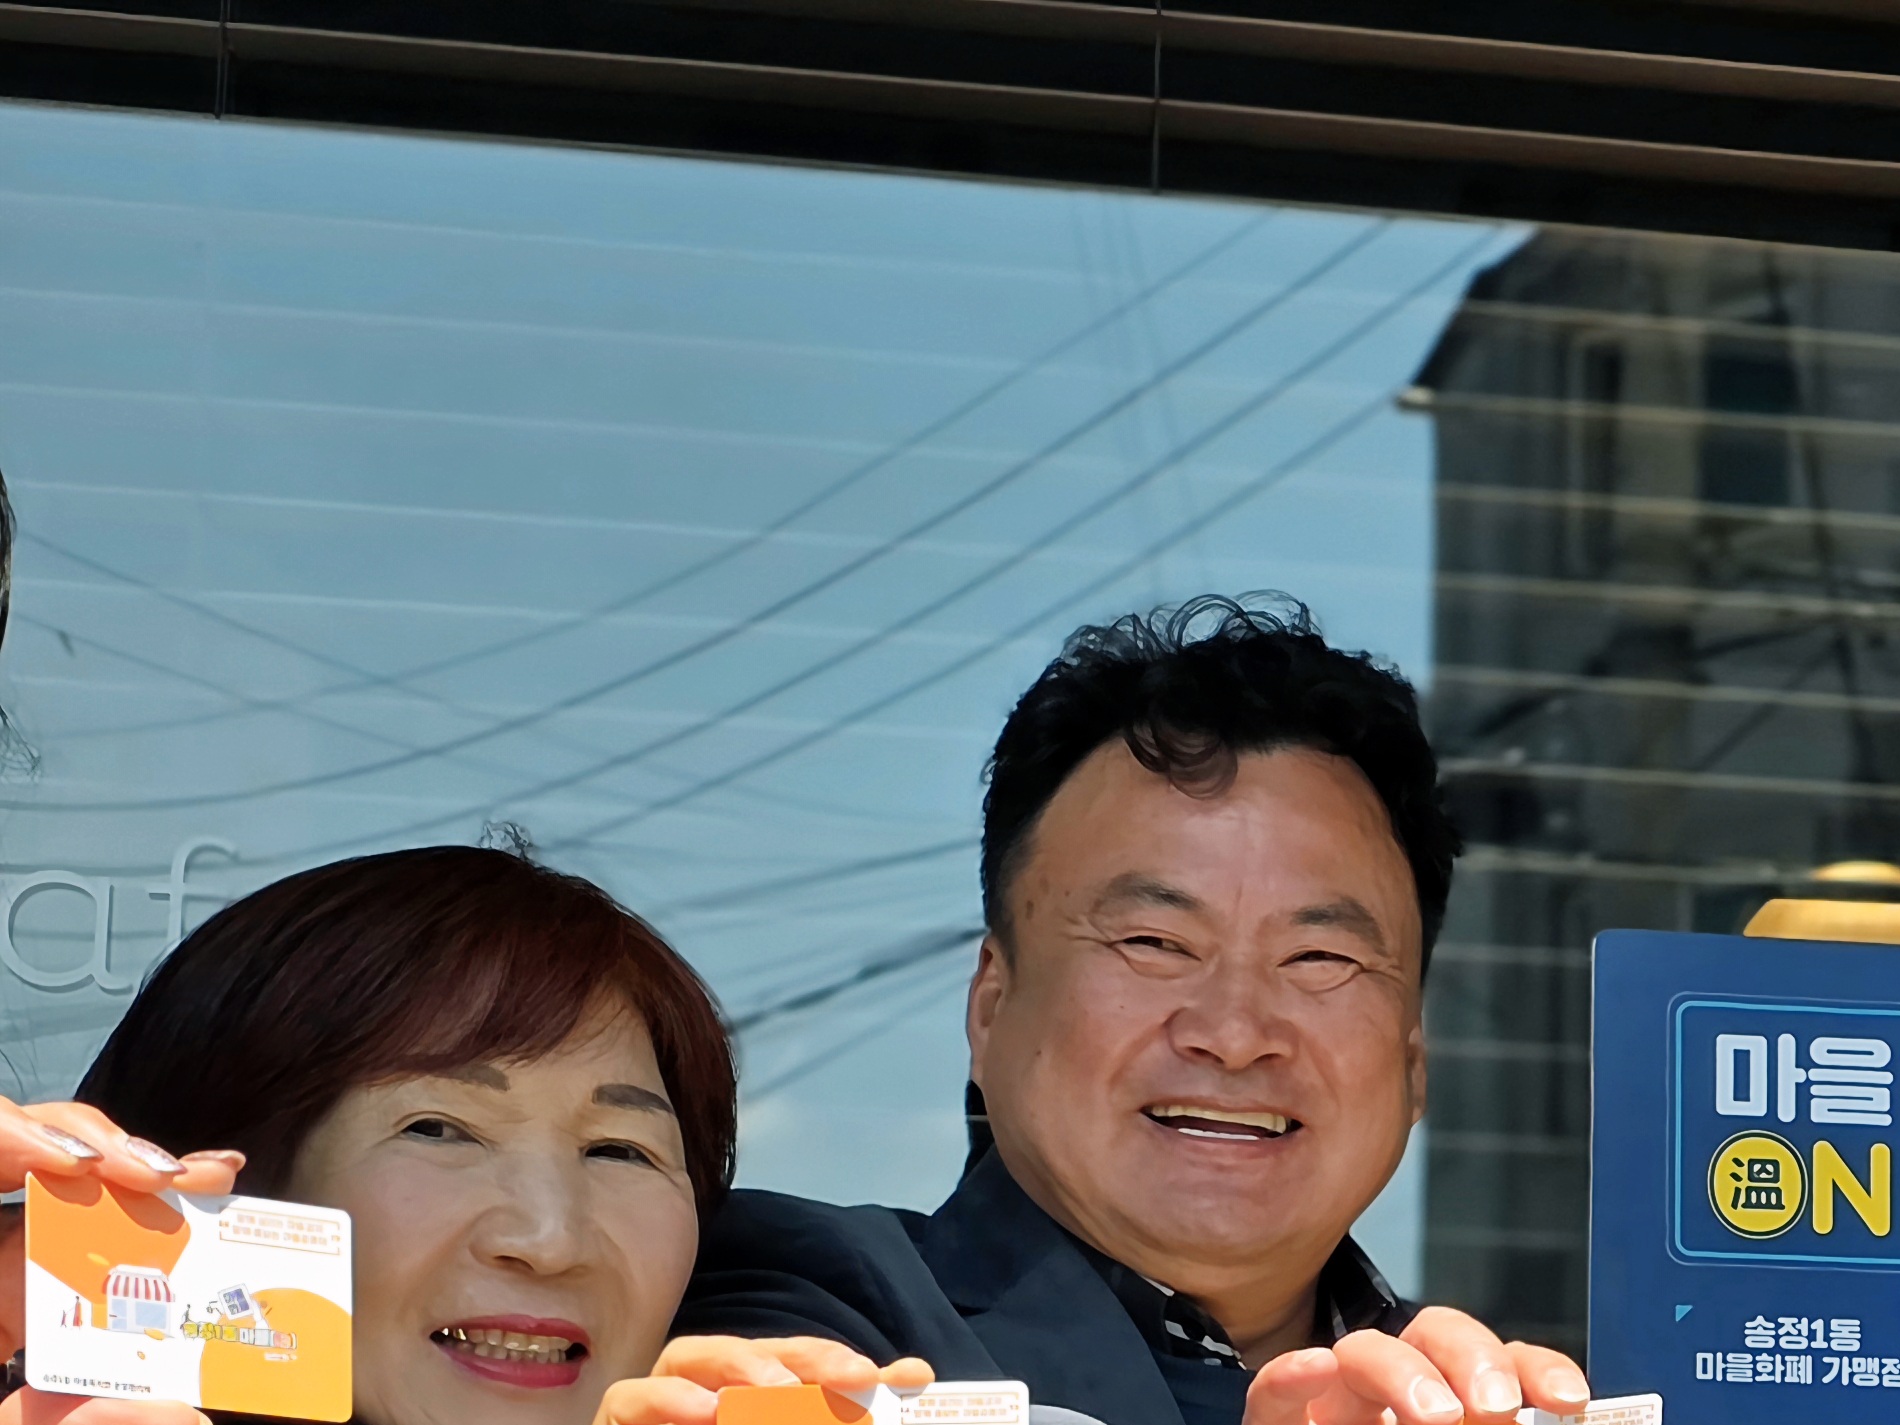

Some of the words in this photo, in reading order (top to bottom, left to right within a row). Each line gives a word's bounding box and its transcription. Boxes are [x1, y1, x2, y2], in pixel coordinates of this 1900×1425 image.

[1716, 1033, 1894, 1127] 마을
[1744, 1315, 1862, 1351] 송정1동
[1696, 1352, 1813, 1385] 마을화폐
